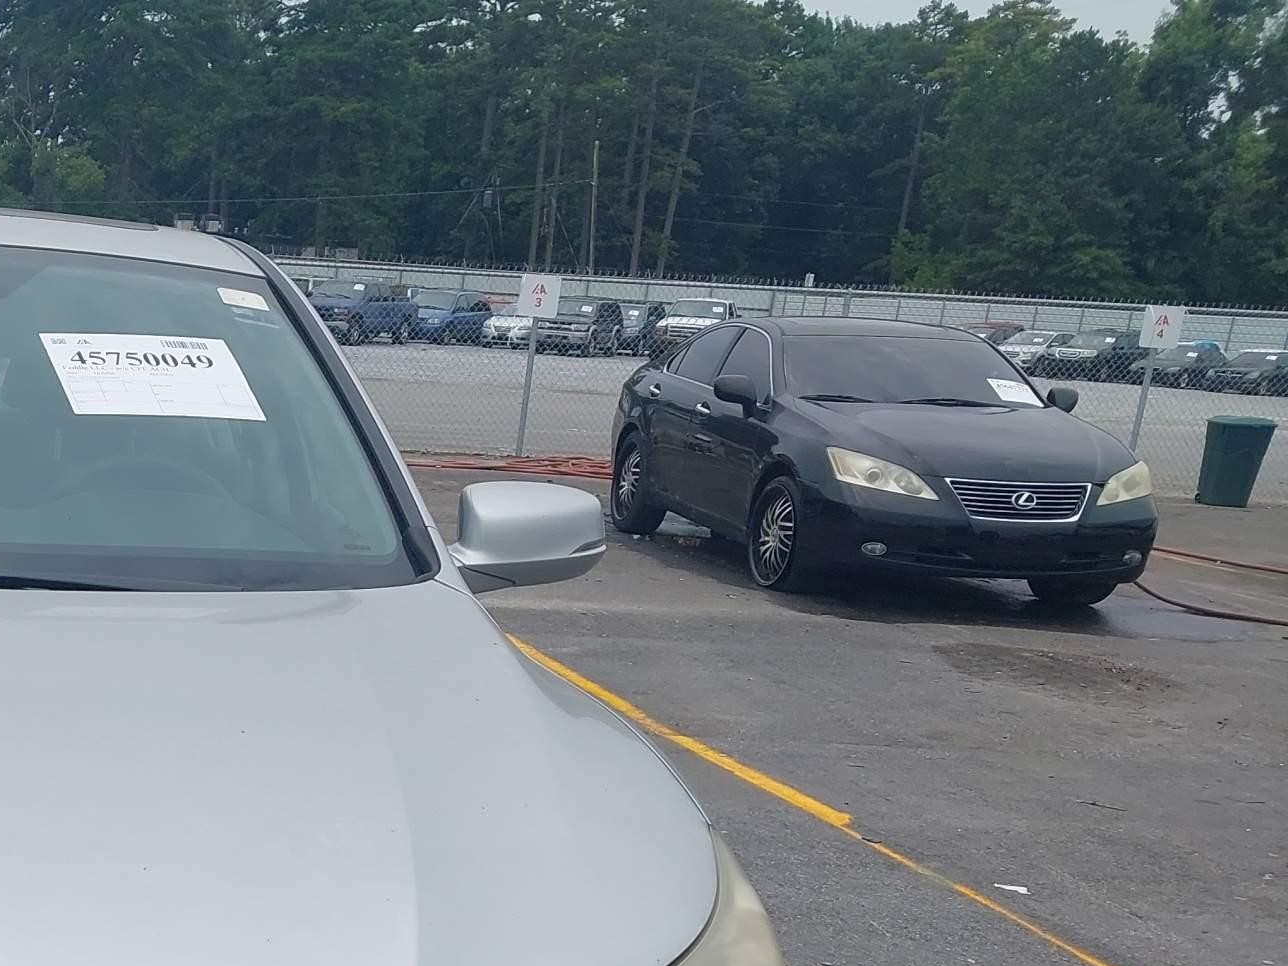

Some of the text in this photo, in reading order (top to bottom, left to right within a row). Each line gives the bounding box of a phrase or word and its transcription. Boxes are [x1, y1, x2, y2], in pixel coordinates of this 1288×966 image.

[535, 297, 542, 308] 3
[1156, 328, 1164, 338] 4
[70, 350, 214, 369] 45750049
